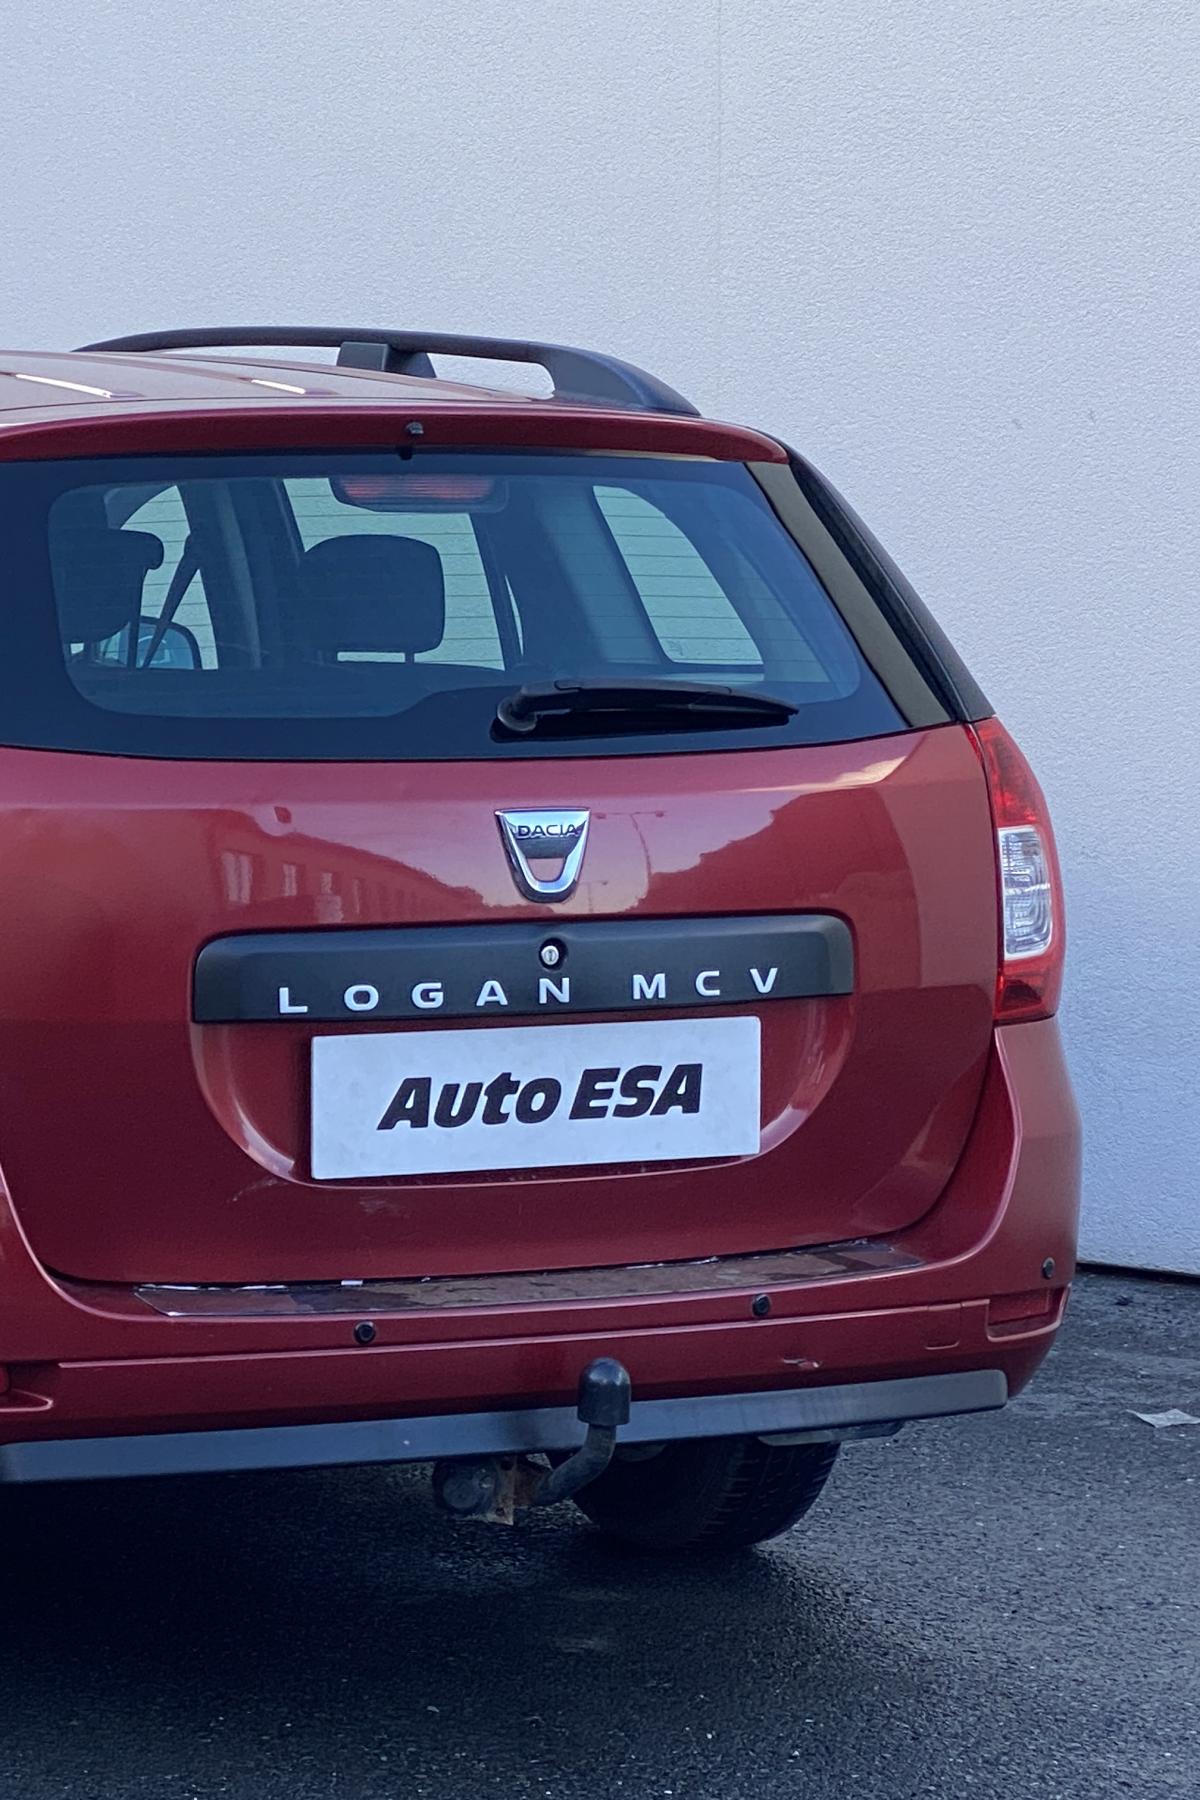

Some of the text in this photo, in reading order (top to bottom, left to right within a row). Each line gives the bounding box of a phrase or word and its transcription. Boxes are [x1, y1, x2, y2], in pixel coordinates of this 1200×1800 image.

[517, 823, 578, 838] DACIA
[278, 967, 779, 1014] LOGAN MCV
[376, 1062, 703, 1131] Auto ESA
